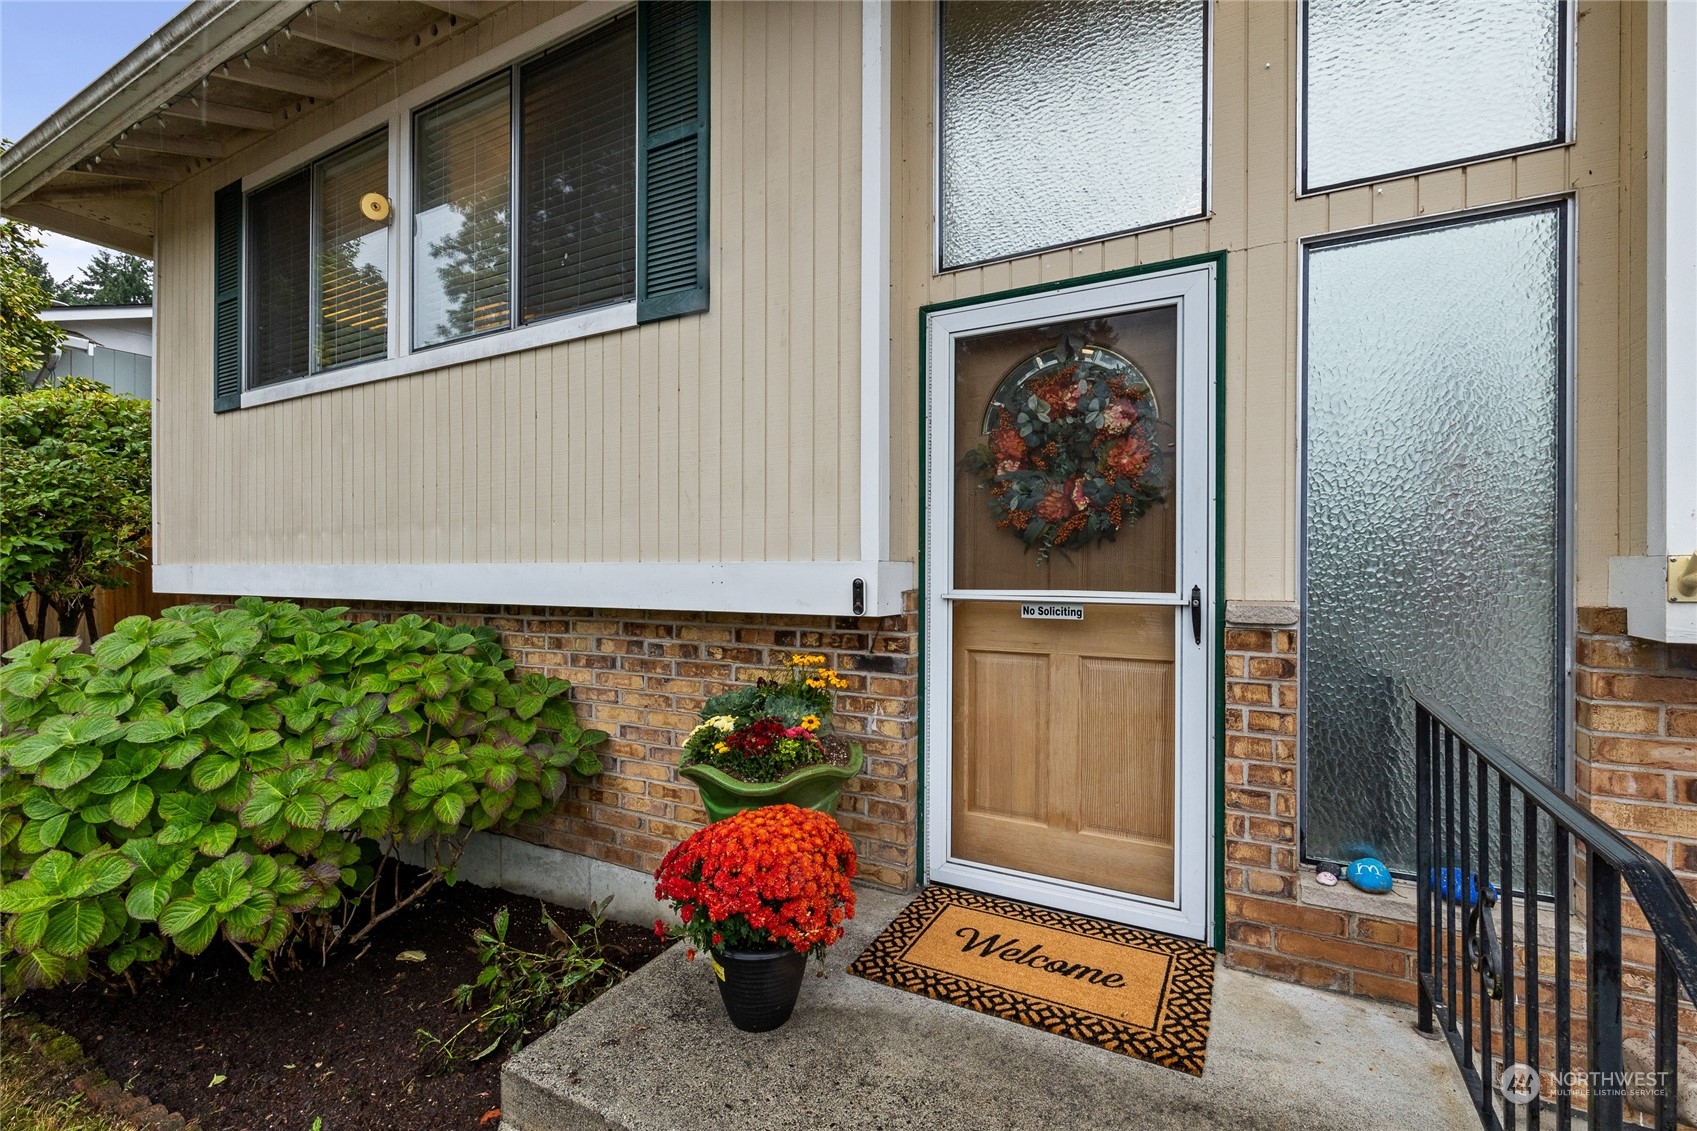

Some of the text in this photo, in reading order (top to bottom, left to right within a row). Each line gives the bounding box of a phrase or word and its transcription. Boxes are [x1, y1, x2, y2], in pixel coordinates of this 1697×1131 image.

[1023, 606, 1082, 619] No Soliciting
[956, 927, 1127, 988] Welcome
